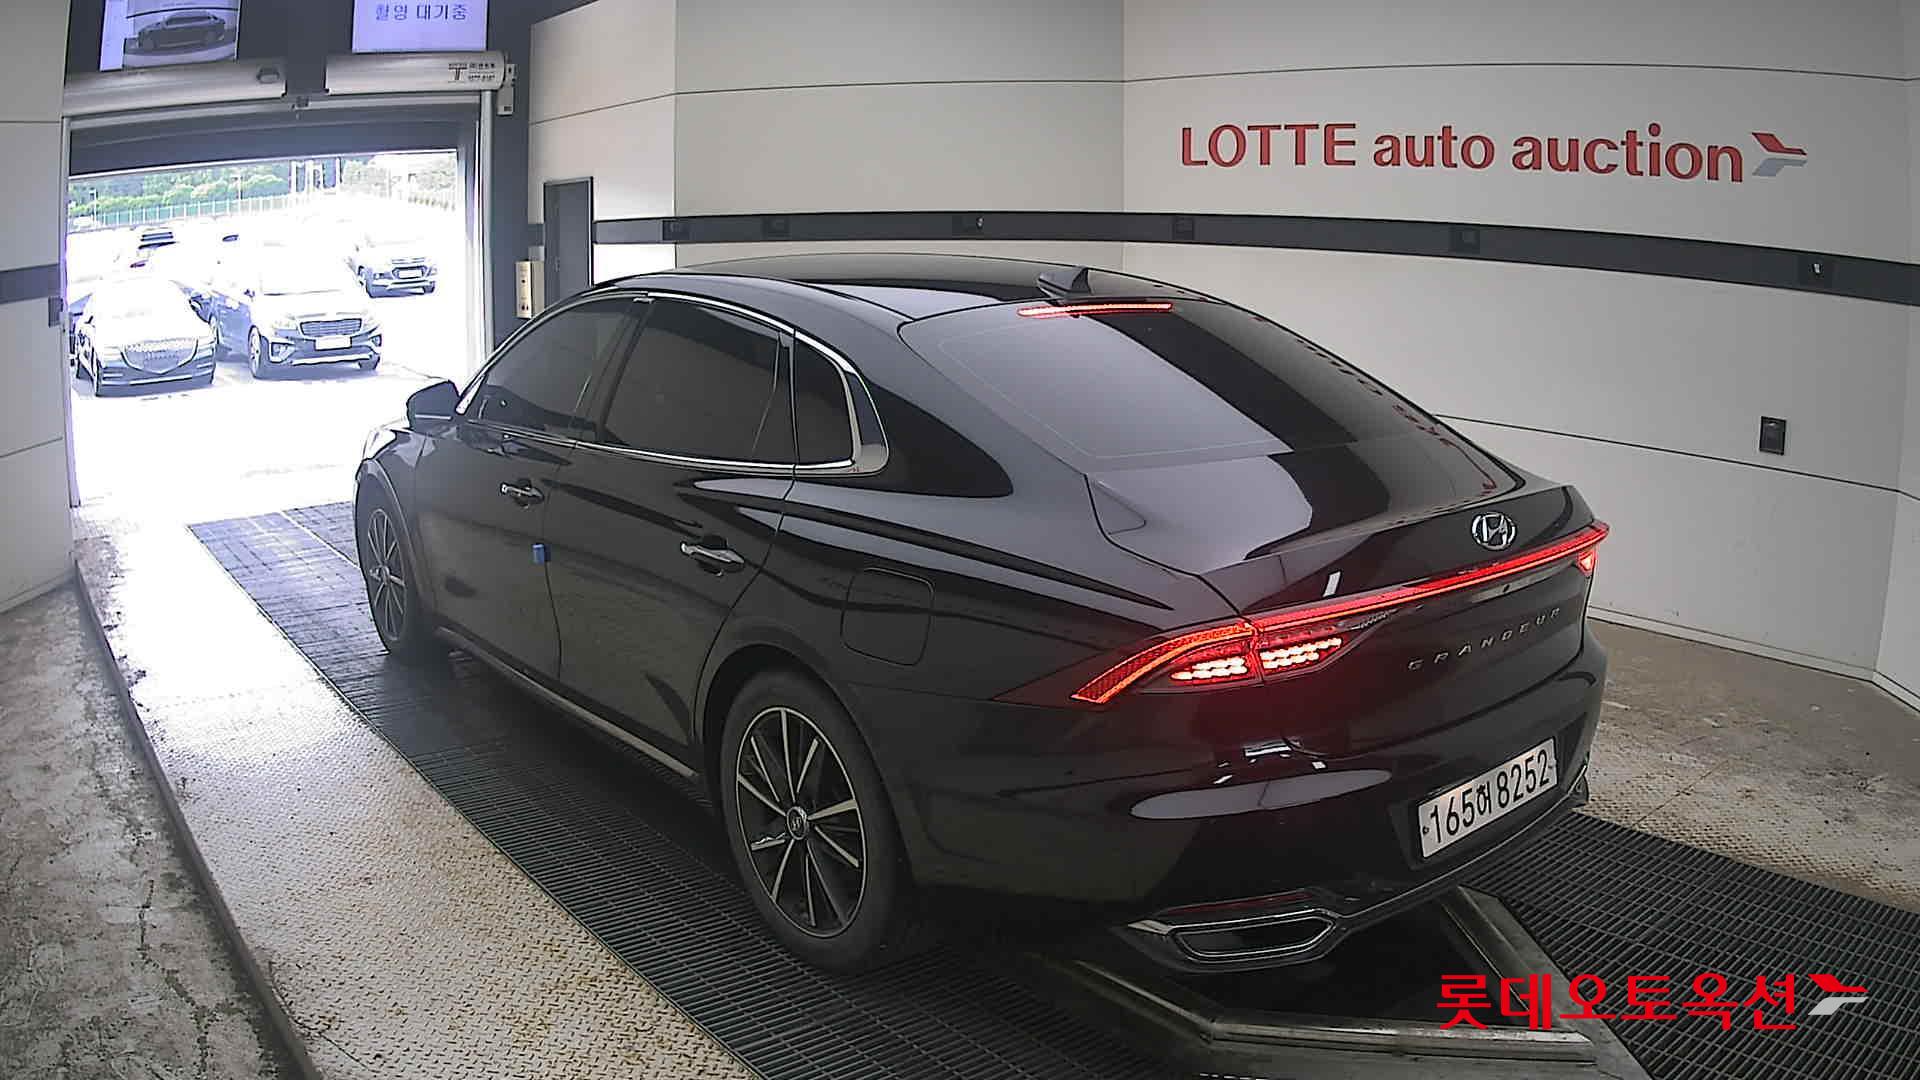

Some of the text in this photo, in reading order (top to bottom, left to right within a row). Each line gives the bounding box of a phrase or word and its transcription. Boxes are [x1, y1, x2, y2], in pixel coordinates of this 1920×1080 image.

[416, 4, 466, 20] 대기중
[1182, 122, 1742, 183] LOTTE auto auction
[1408, 606, 1560, 672] GRANDEUR
